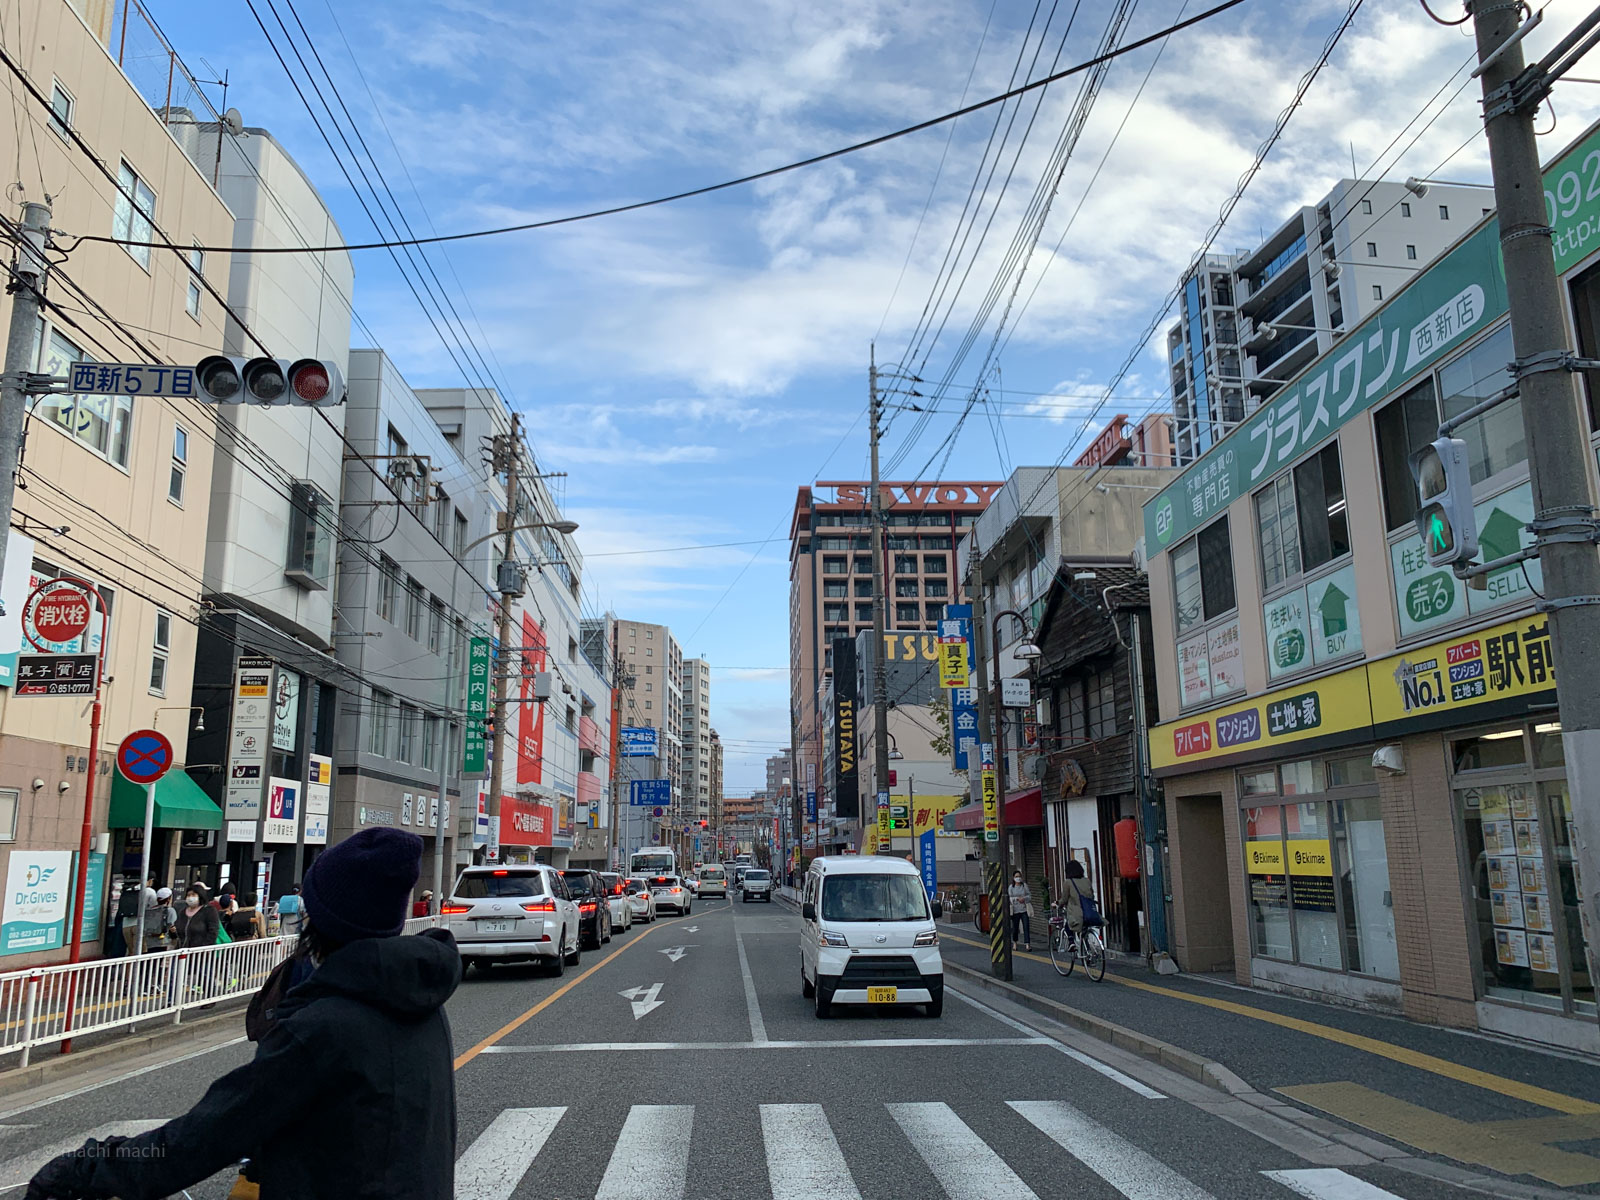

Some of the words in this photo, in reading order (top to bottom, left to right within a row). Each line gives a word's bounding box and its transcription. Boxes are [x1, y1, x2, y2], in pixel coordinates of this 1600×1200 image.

[1415, 291, 1475, 356] 西新店
[73, 366, 193, 395] 西新5丁目
[1250, 326, 1400, 481] プラスワン
[1186, 449, 1233, 496] 不動産売買の
[1191, 473, 1230, 518] 専門店
[1156, 503, 1172, 537] 2F
[1401, 543, 1427, 576] 住ま
[1411, 576, 1449, 619] 売る
[1487, 572, 1527, 600] SELL
[38, 604, 87, 627] 消火栓
[942, 620, 961, 637] 質
[1270, 603, 1301, 629] 住まいを
[1327, 634, 1347, 654] BUY
[1448, 642, 1479, 662] アパート
[19, 664, 92, 677] 真子質店
[947, 645, 962, 674] 真子
[1451, 662, 1482, 680] マンション
[58, 684, 90, 692] 851-0777
[1402, 671, 1446, 710] No.1
[1453, 680, 1484, 700] 土地・家
[1270, 696, 1316, 733] 土地・家
[839, 700, 854, 773] TSUTAYA
[1175, 730, 1210, 754] アパート
[1217, 714, 1257, 744] マンション
[524, 737, 538, 760] BEST
[285, 799, 292, 808] UR
[984, 776, 995, 810] 真子
[1259, 852, 1279, 864] Ekimae
[1302, 852, 1325, 864] Ekimae
[875, 993, 896, 1001] 10-88
